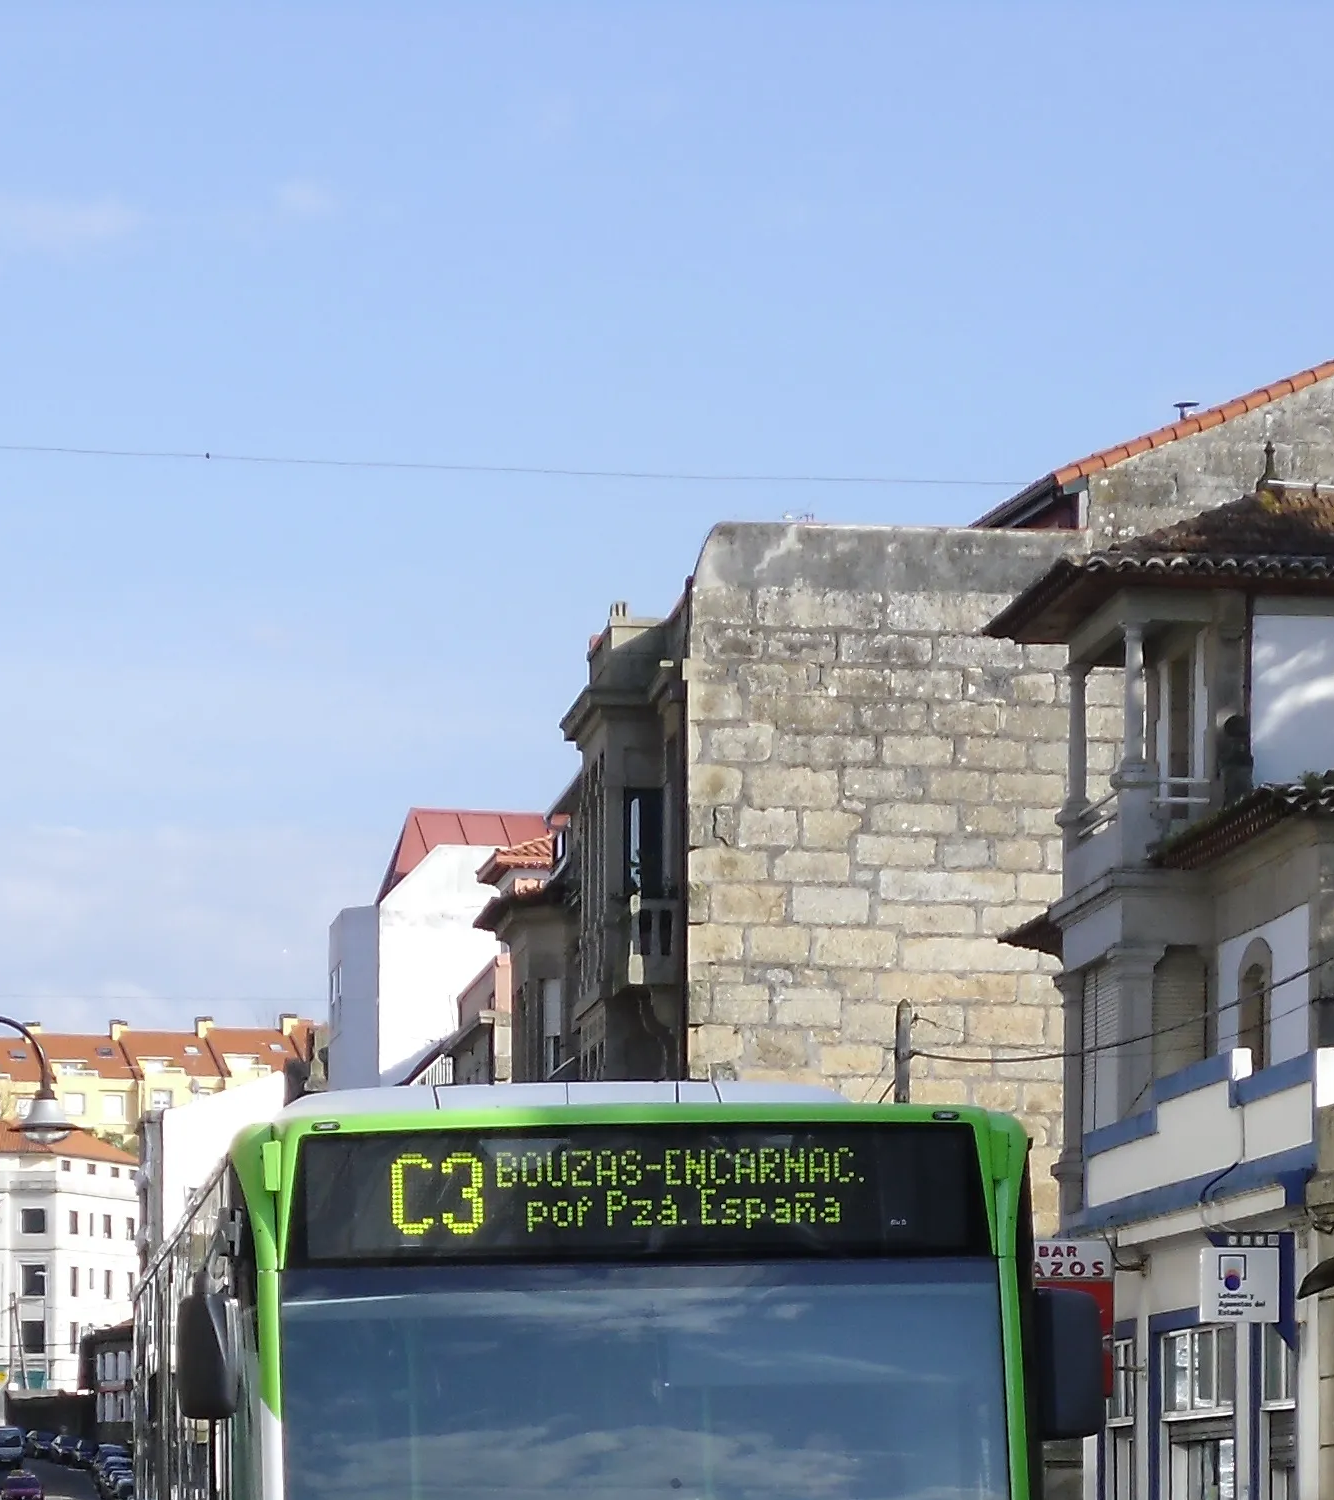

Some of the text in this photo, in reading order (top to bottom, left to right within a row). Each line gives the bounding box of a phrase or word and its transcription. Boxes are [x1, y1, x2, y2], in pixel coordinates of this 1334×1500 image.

[495, 1147, 866, 1189] BOUZAS-ENCARNAC.
[390, 1152, 485, 1235] C3
[526, 1188, 843, 1233] por Pza. España
[1038, 1245, 1078, 1258] BAR
